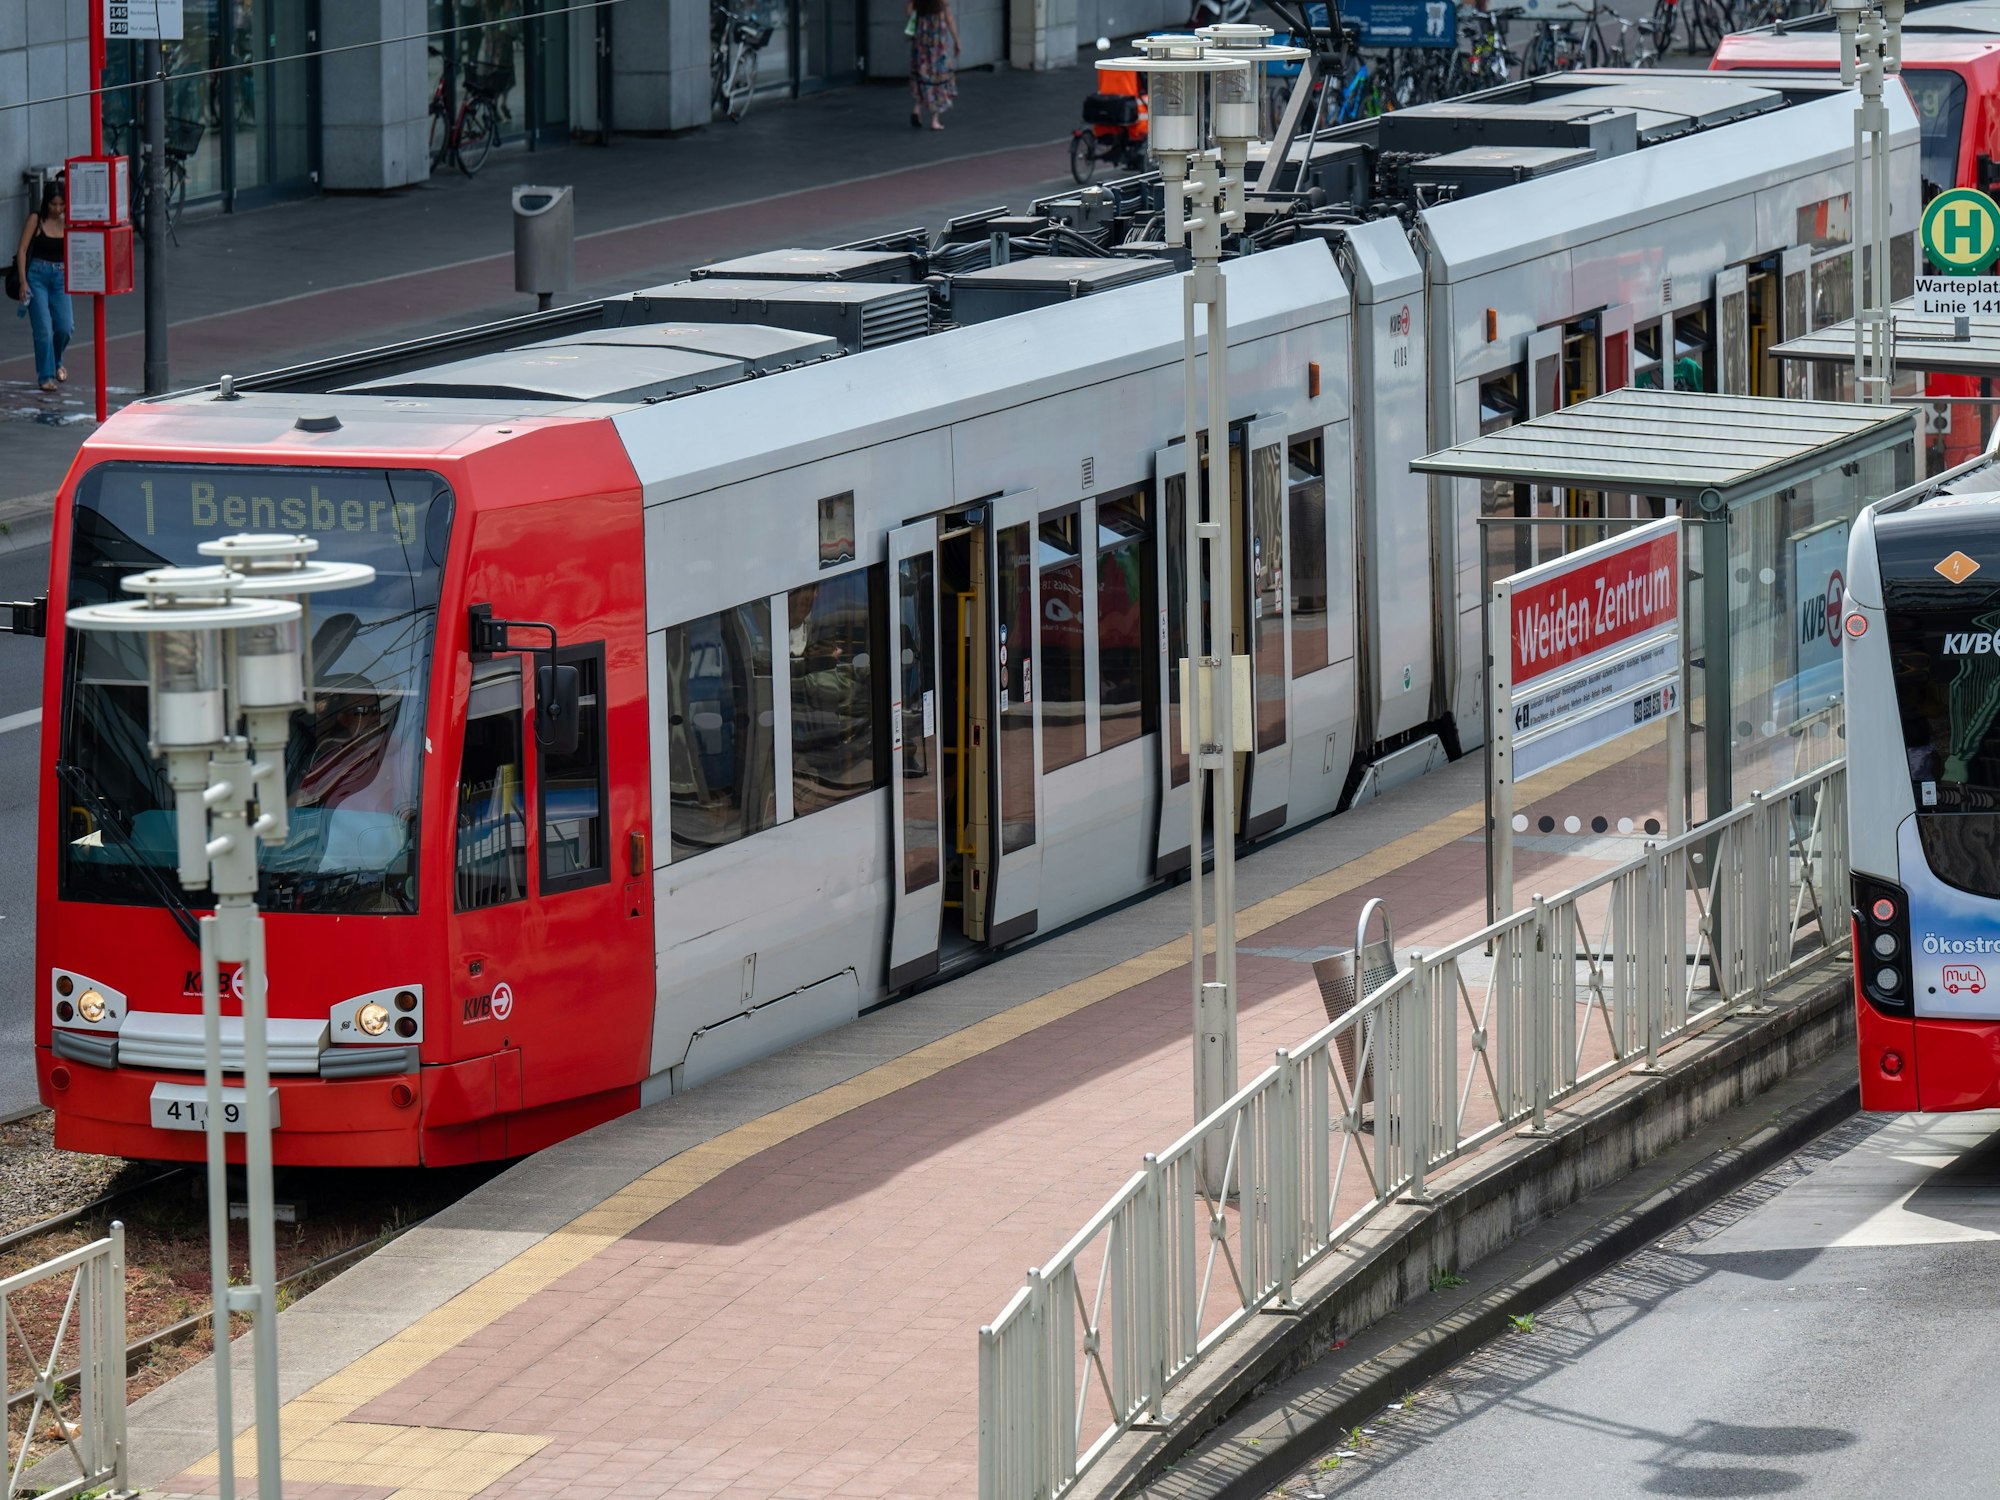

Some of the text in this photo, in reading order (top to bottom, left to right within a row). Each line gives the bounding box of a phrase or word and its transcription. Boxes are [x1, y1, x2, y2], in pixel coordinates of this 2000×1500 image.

[110, 8, 127, 17] 145
[110, 23, 127, 33] 149
[1944, 209, 1981, 254] H
[1916, 279, 2000, 296] Warteplat
[1924, 299, 2000, 313] Linie 141
[140, 480, 416, 545] 1 Bensberg
[1518, 565, 1670, 666] Weiden Zentrum
[1802, 593, 1826, 645] KVB
[1943, 633, 1992, 654] KVB
[183, 971, 231, 993] KB
[463, 994, 491, 1021] KVB
[167, 1101, 240, 1123] 419
